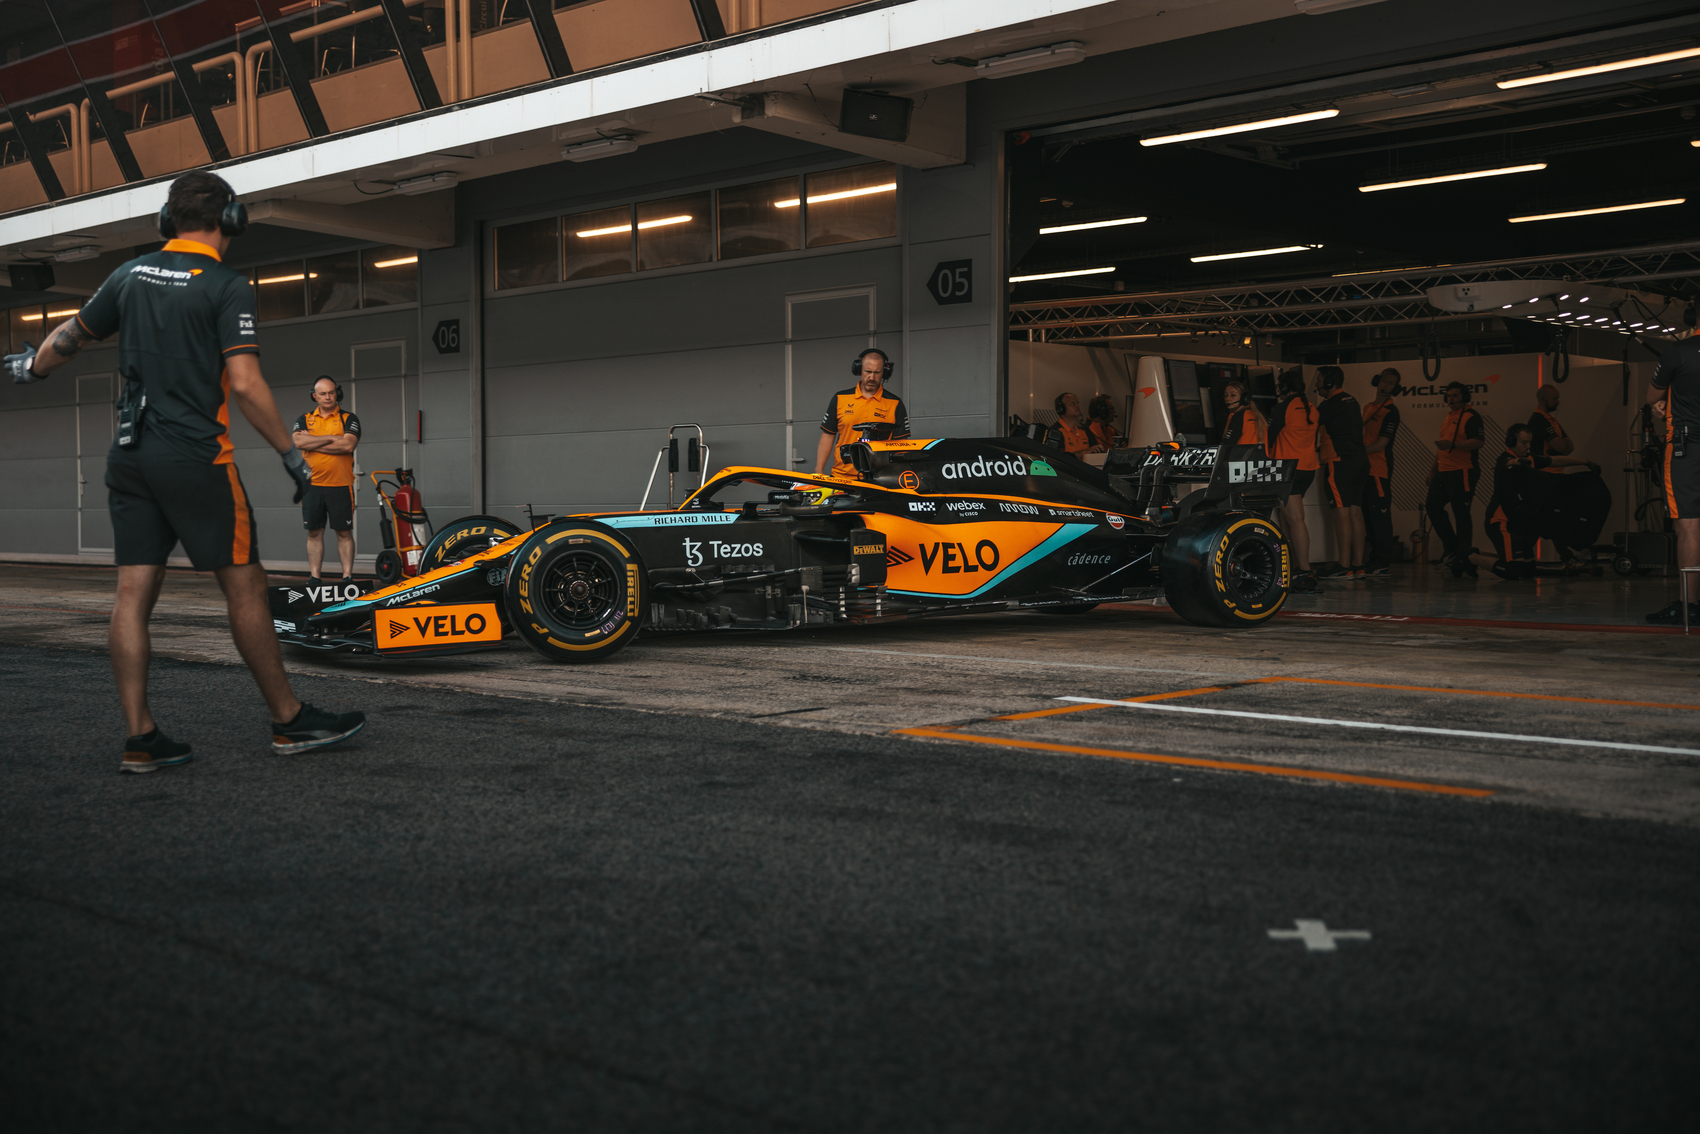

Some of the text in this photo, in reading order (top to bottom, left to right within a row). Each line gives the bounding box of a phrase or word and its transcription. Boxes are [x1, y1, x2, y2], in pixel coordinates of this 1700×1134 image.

[130, 265, 192, 280] McLaren
[938, 268, 969, 298] 05
[439, 325, 458, 348] 06
[1400, 384, 1488, 397] McLaen
[941, 455, 1027, 480] android
[1228, 459, 1283, 484] OKX
[904, 473, 916, 489] E
[908, 502, 937, 511] OKX
[946, 500, 986, 511] webex
[1057, 510, 1095, 518] smartsheet
[654, 515, 732, 525] RICHARD MILLE
[435, 526, 487, 563] ZERO
[708, 541, 764, 559] Tezos
[918, 539, 1000, 577] VELO
[1214, 535, 1230, 592] ZERO
[1281, 544, 1290, 588] PIRELLI
[520, 546, 542, 614] ZERO
[626, 563, 640, 617] PIRELLI
[305, 584, 360, 603] VELO
[386, 584, 440, 607] McLaren
[1223, 599, 1237, 608] P
[413, 613, 486, 638] VELO
[531, 623, 549, 634] P
